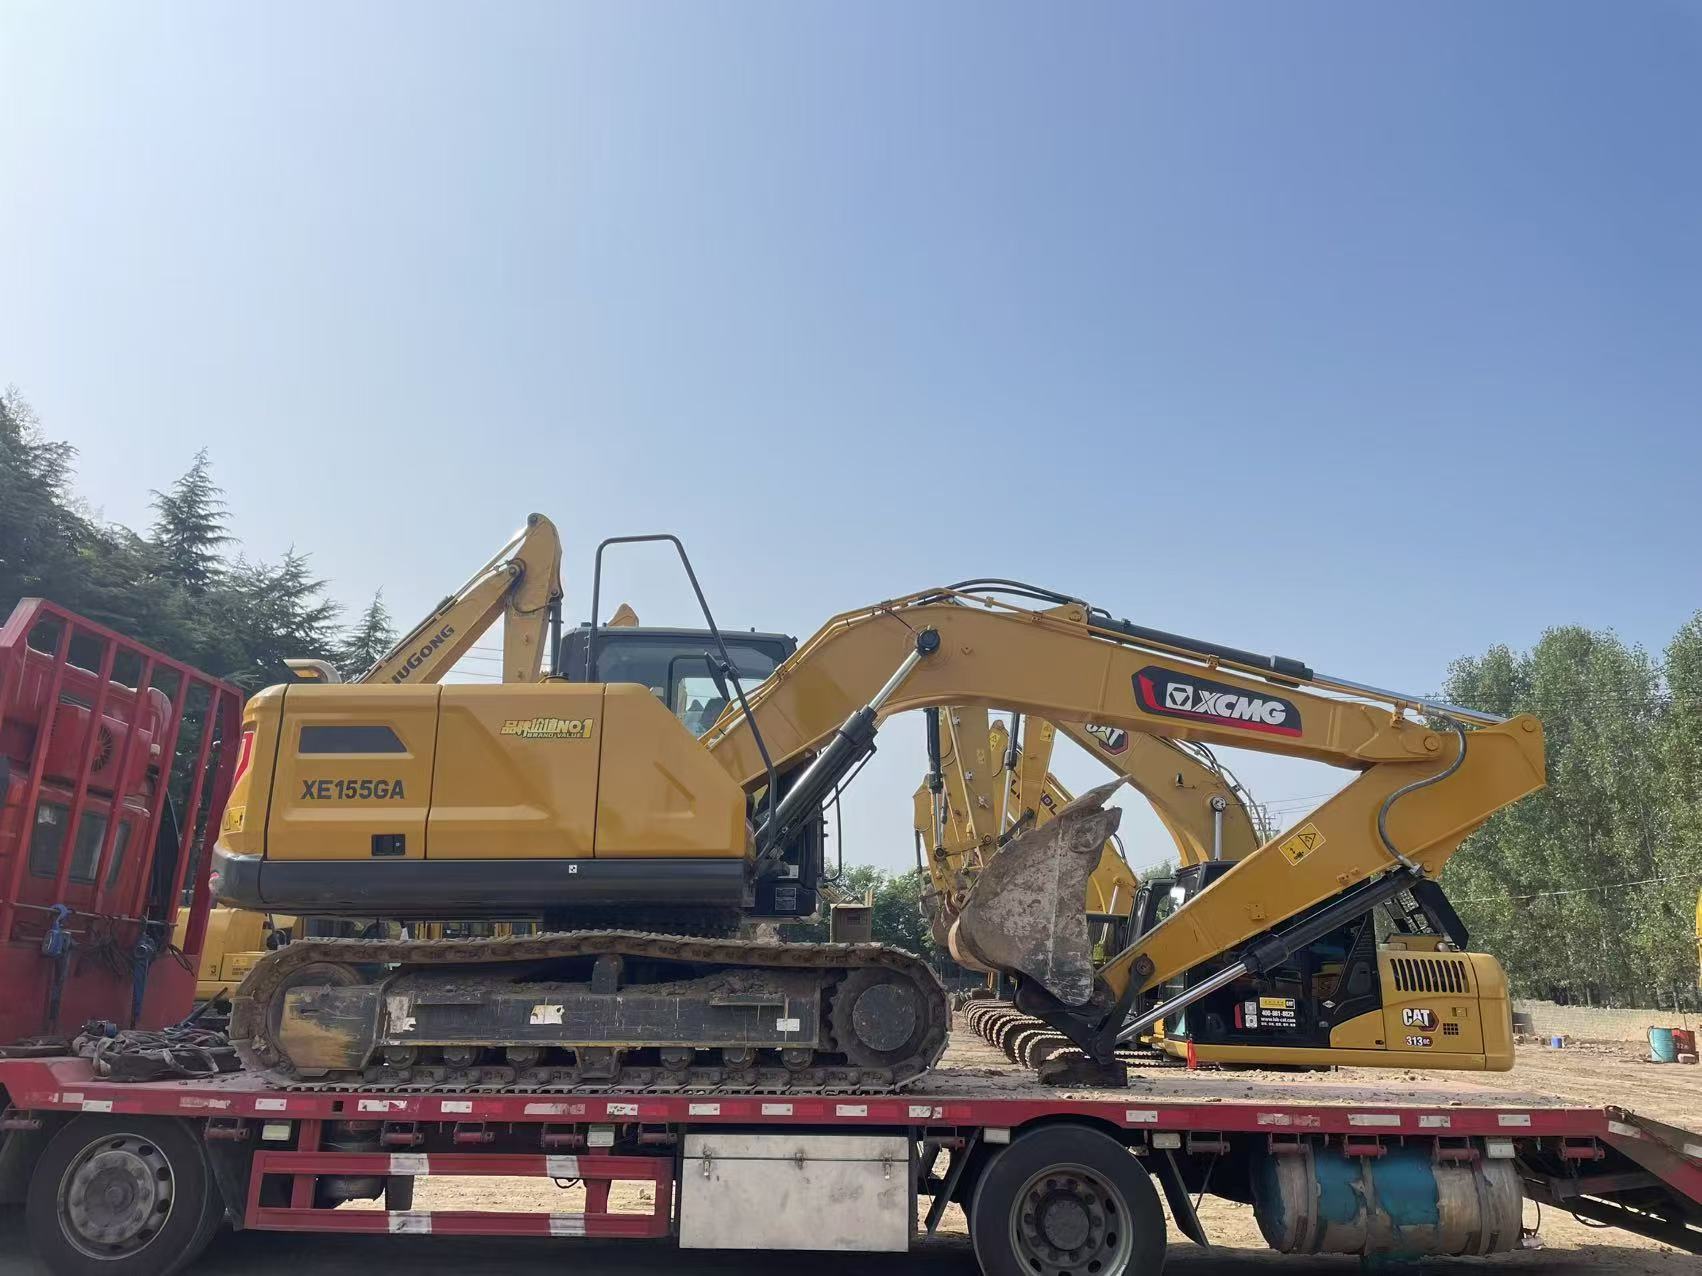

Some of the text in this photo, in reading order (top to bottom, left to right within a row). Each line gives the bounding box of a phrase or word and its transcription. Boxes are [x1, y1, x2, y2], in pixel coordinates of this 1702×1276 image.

[392, 624, 455, 684] IUGONG
[1192, 690, 1286, 725] XCMG
[301, 779, 405, 800] XE155GA
[1402, 1008, 1430, 1027] CAT
[1406, 1036, 1423, 1046] 313
